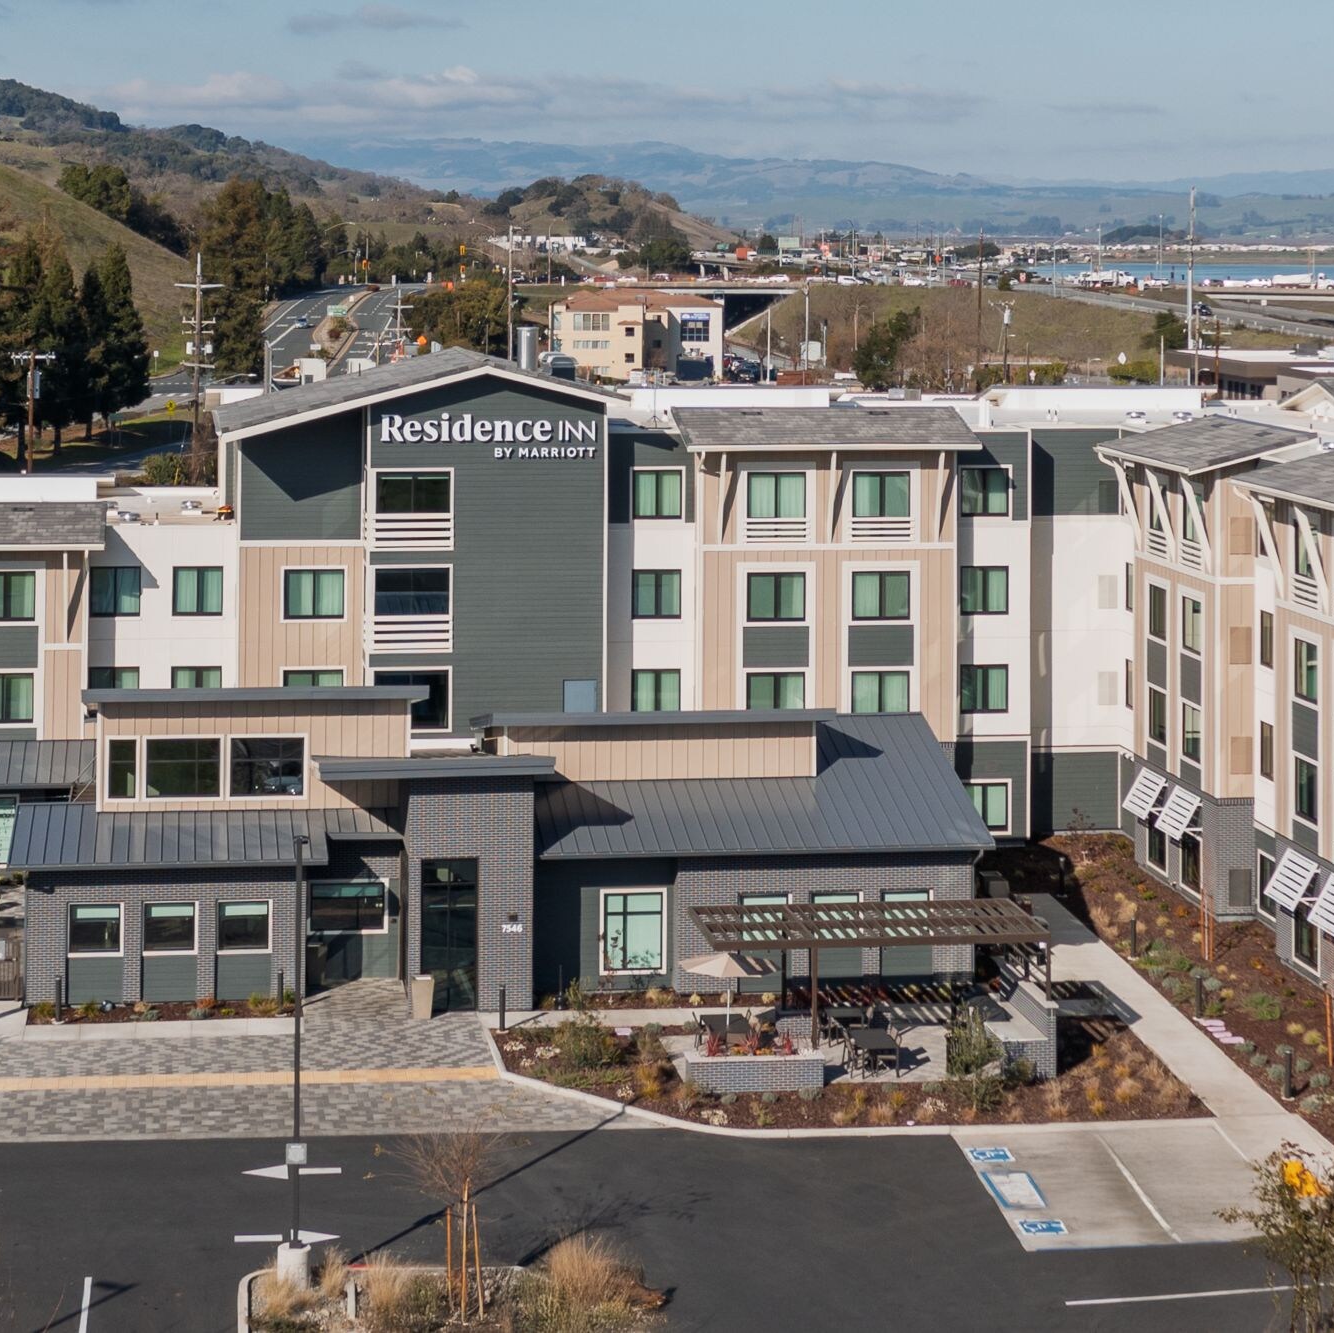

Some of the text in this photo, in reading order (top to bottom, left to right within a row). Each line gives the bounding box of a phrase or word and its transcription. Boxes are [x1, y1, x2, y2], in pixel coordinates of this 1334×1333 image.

[380, 412, 596, 442] Residence INN
[494, 447, 596, 458] BY MARRIOTT
[501, 924, 523, 933] 7546
